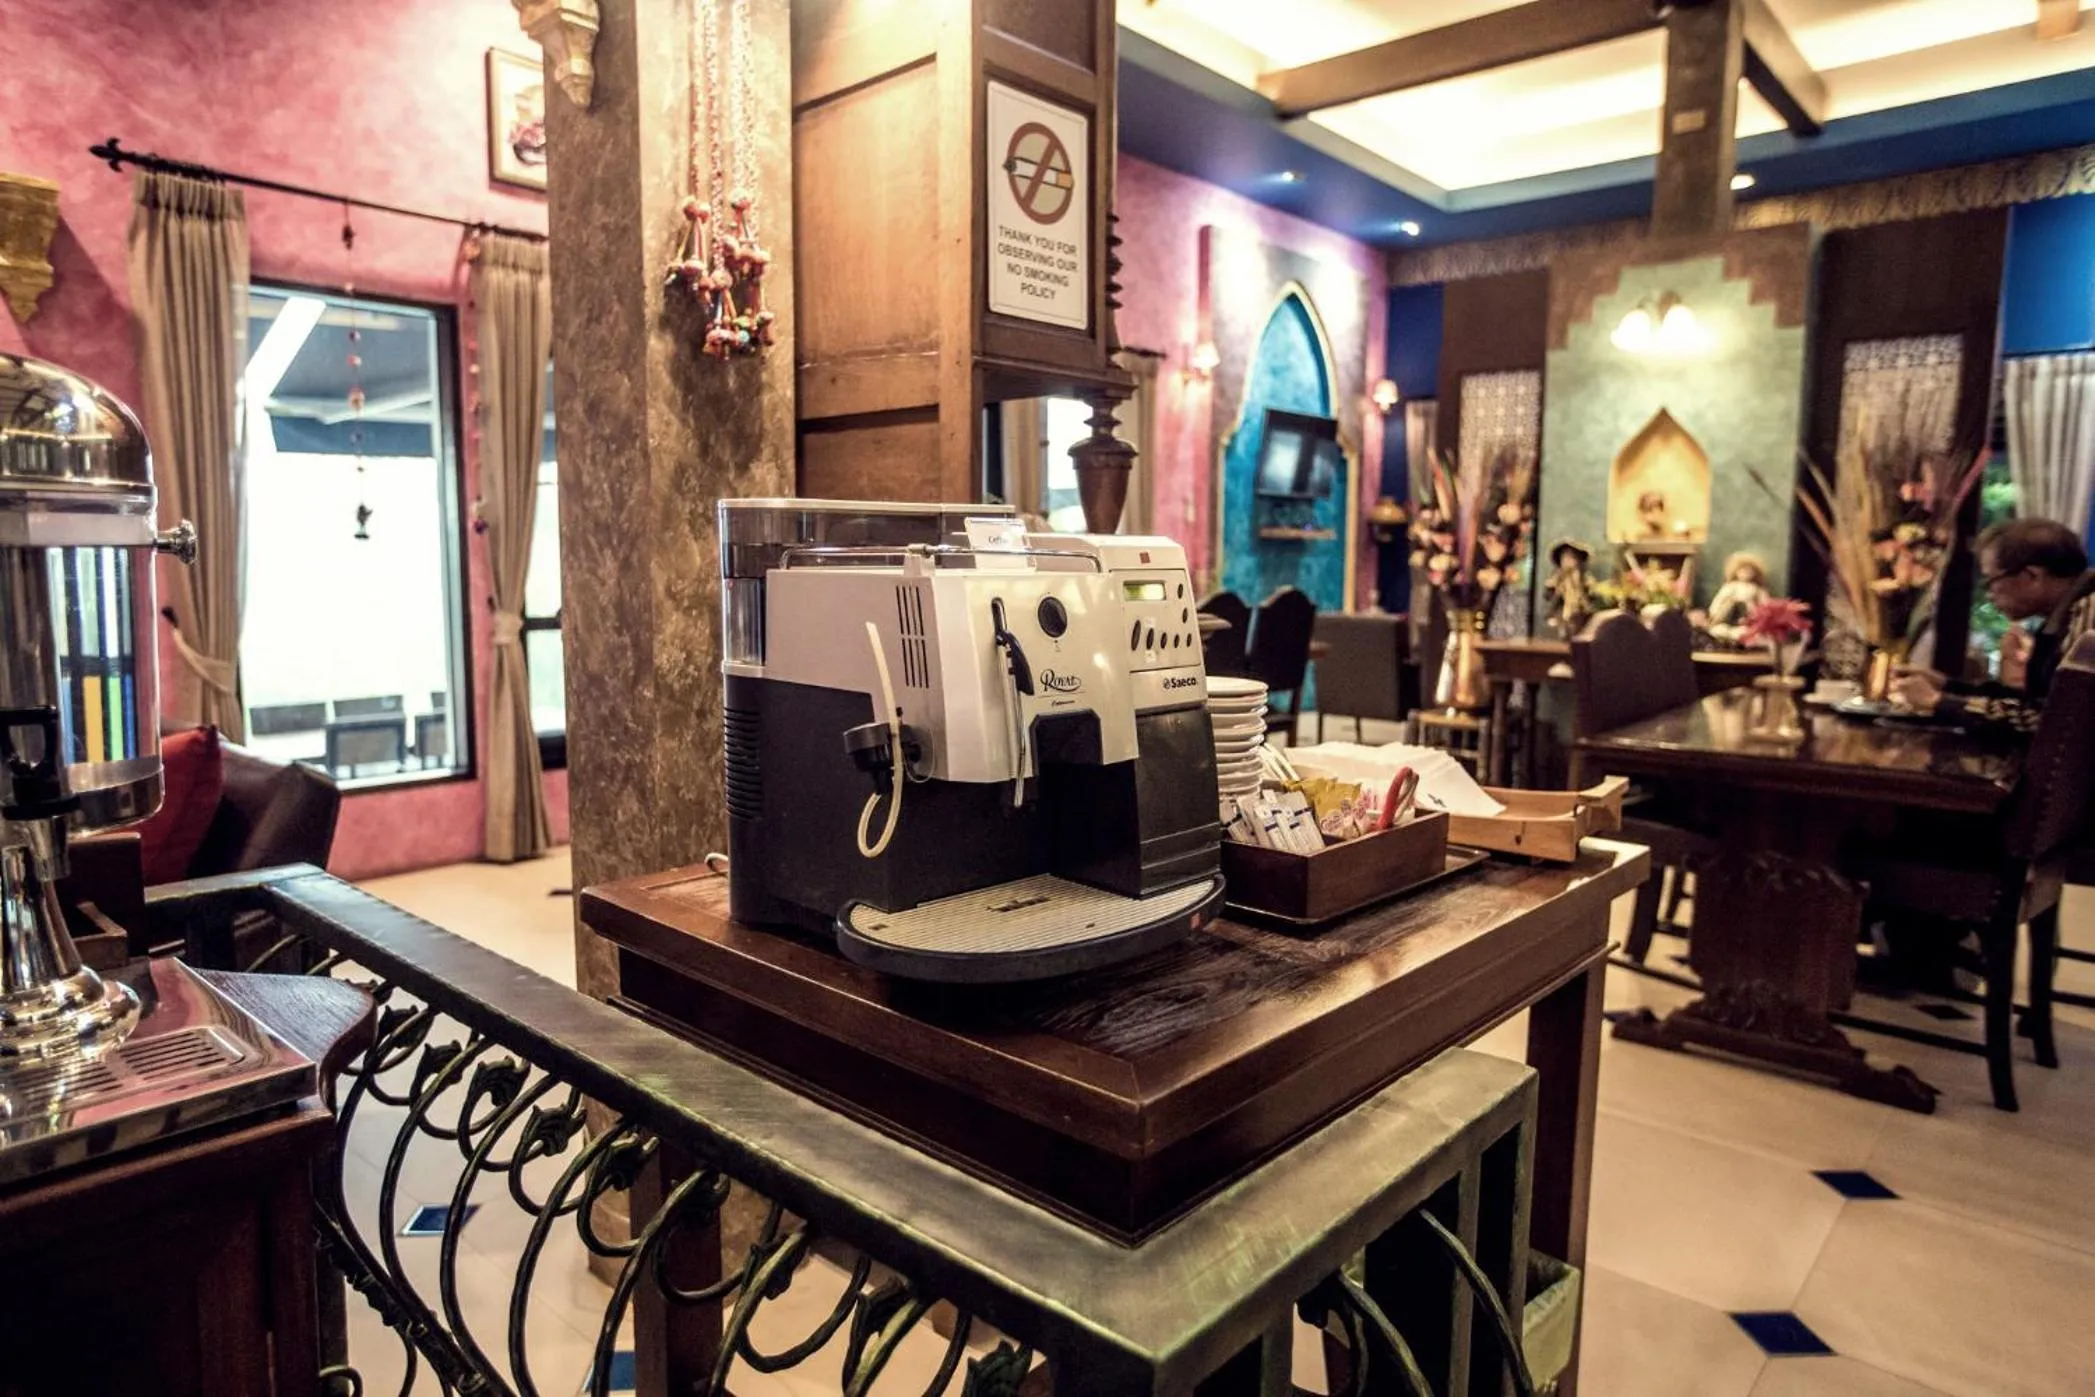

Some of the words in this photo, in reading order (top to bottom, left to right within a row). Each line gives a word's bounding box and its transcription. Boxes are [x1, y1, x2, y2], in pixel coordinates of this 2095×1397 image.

[998, 225, 1032, 244] THANK
[1034, 236, 1054, 251] YOU
[1057, 241, 1076, 256] FOR
[997, 242, 1054, 267] OBSERVING
[1056, 258, 1077, 272] OUR
[1007, 262, 1022, 275] NO
[1024, 266, 1068, 287] SMOKING
[1020, 282, 1056, 299] POLICY
[1171, 677, 1197, 688] Saeco
